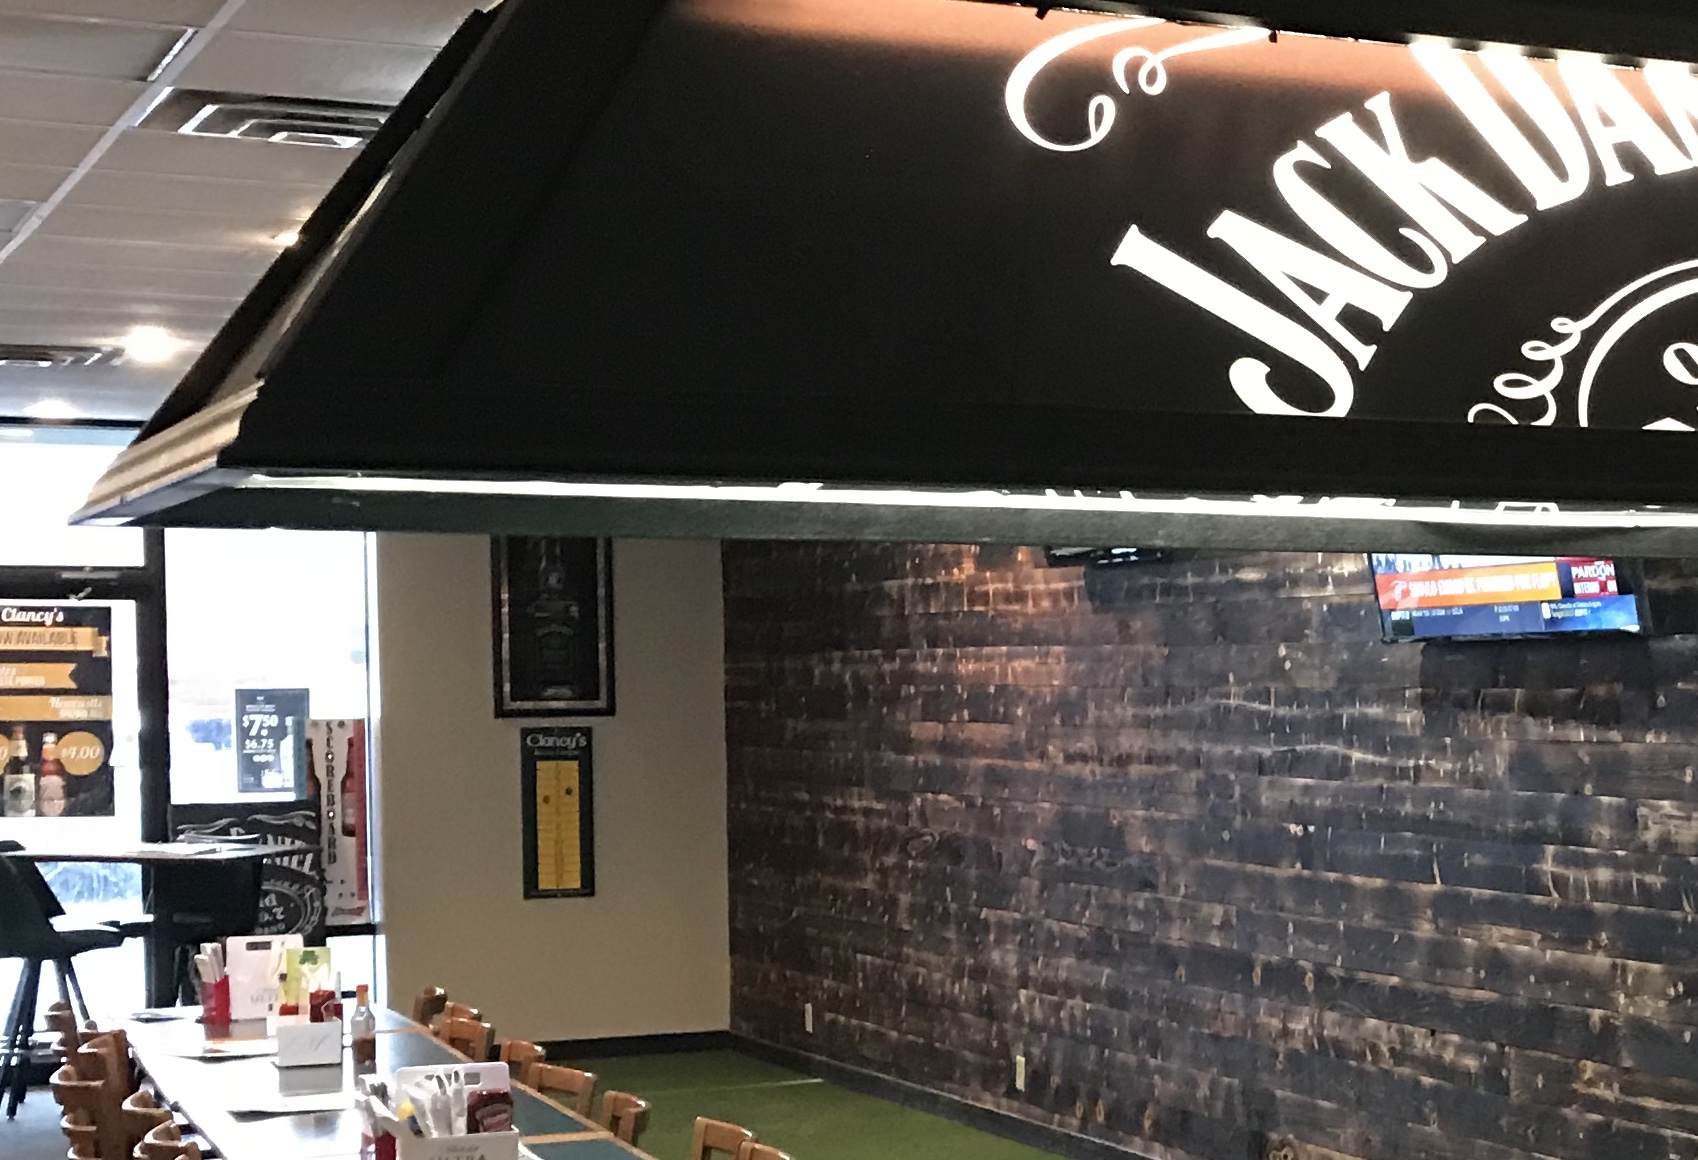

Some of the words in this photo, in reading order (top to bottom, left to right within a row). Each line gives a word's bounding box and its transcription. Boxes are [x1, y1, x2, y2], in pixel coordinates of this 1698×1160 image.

[1110, 91, 1528, 417] JACK
[1570, 562, 1616, 579] PARDON
[1, 607, 64, 626] Clancy's
[525, 732, 587, 750] Clancy's
[325, 720, 338, 865] SCOREBOARD
